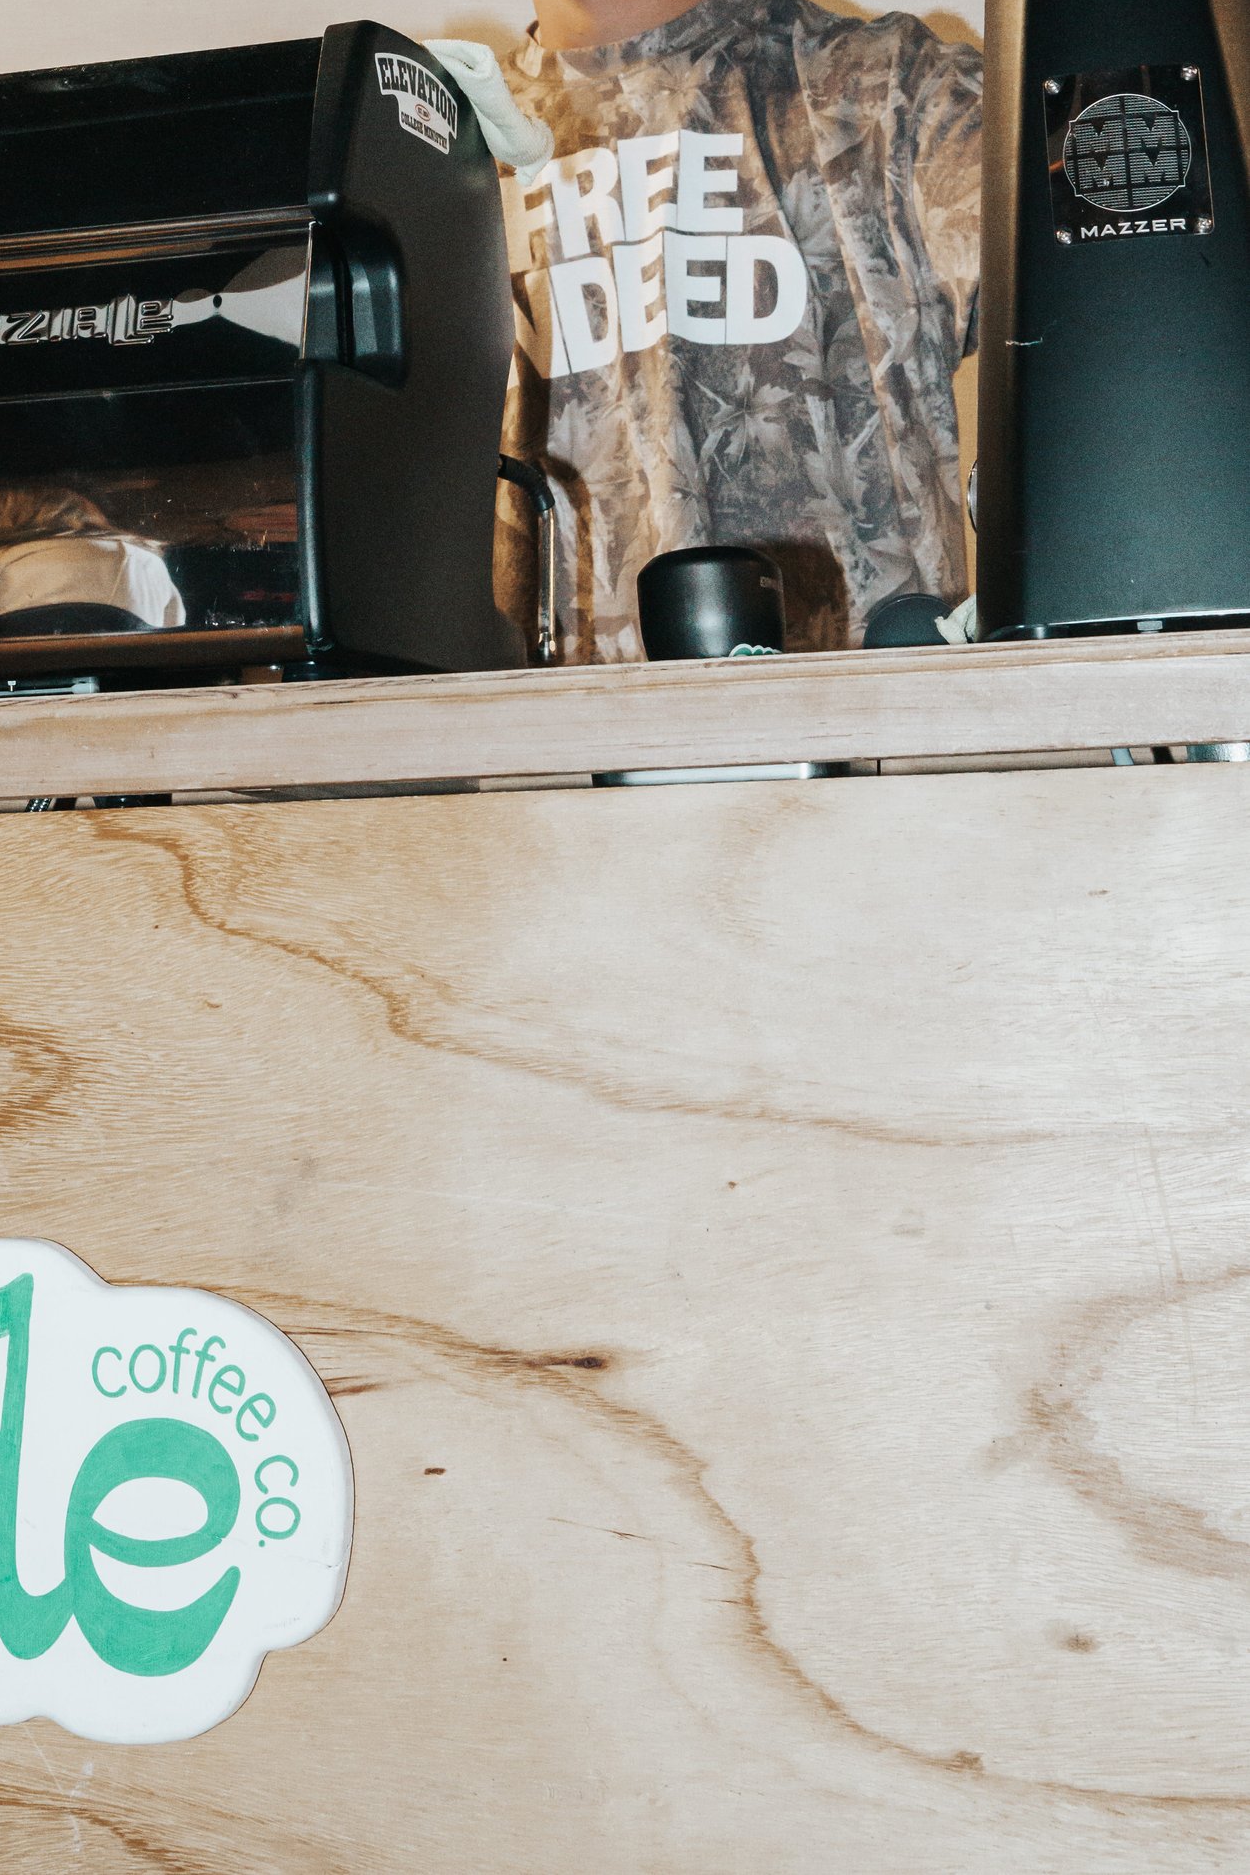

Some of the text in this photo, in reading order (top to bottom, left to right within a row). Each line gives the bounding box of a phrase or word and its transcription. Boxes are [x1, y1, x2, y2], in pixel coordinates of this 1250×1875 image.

[377, 57, 457, 133] ELEVATION
[500, 129, 744, 273] FREE
[1080, 218, 1186, 239] MAZZER
[91, 1327, 301, 1548] coffee co.
